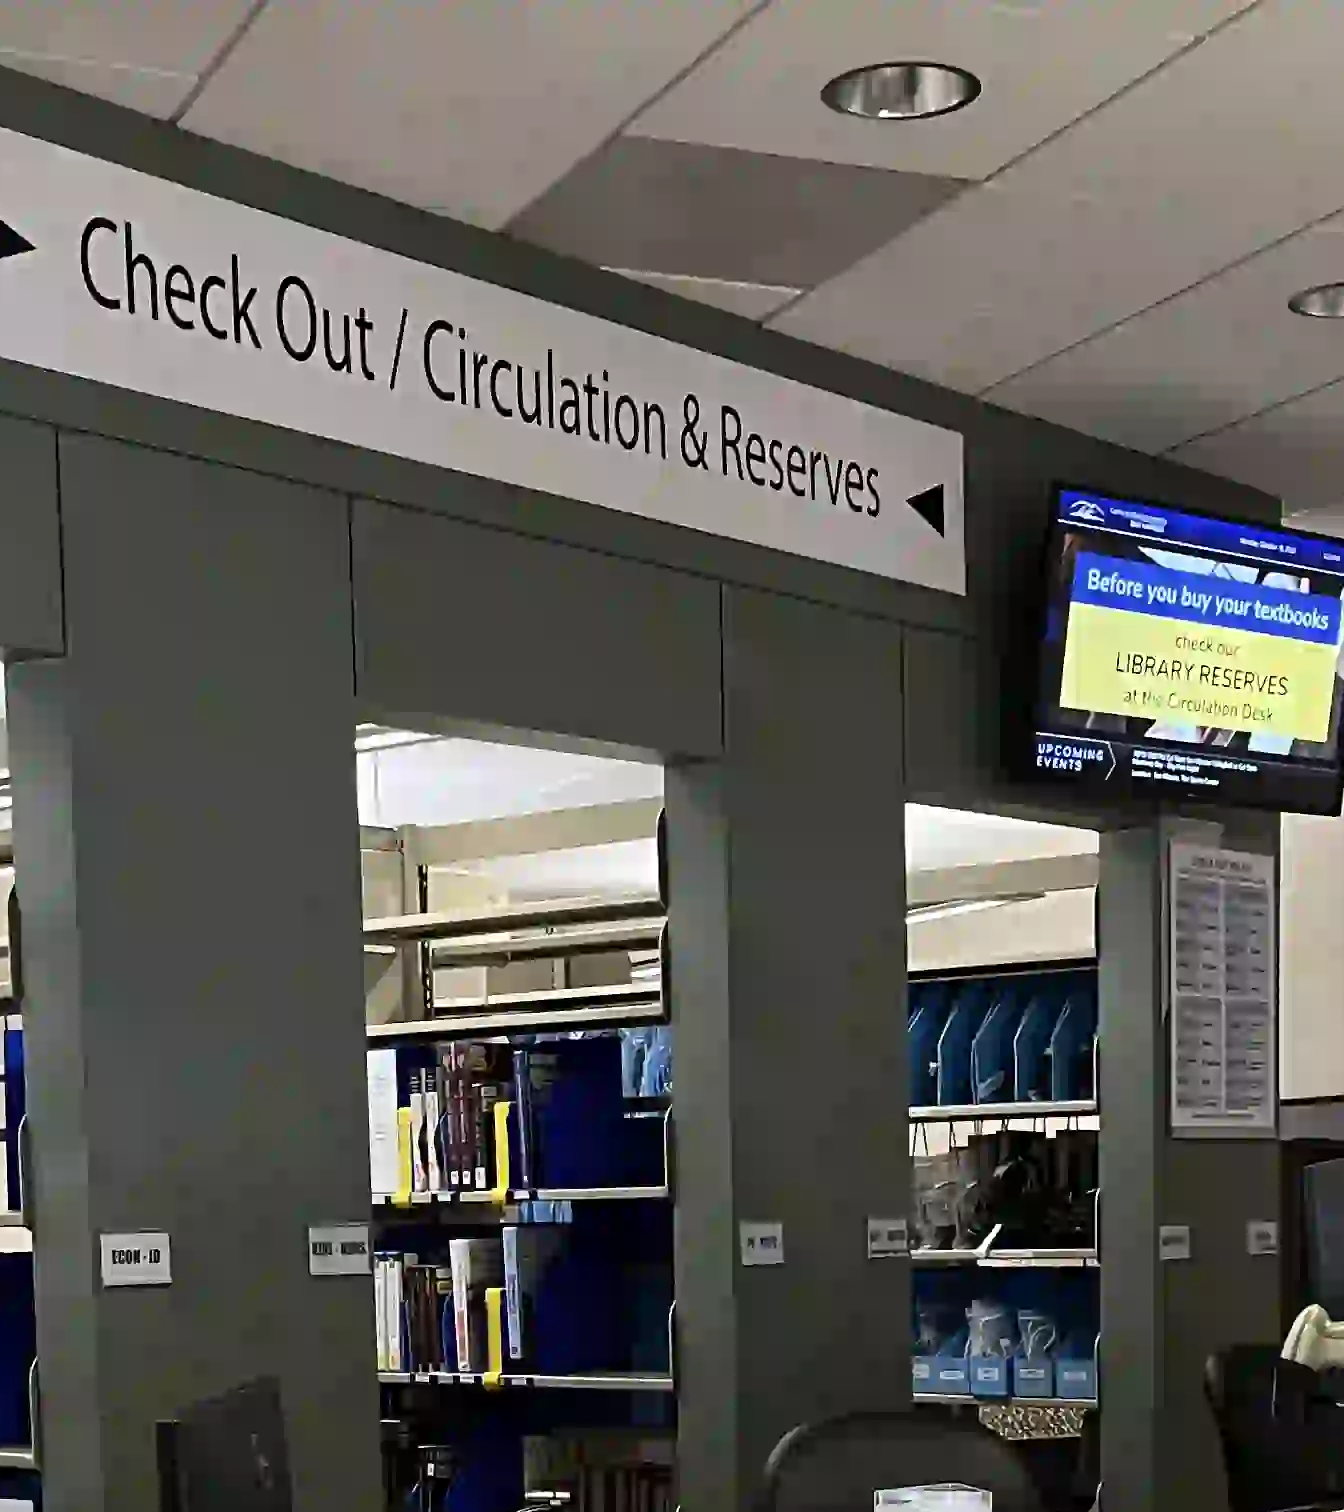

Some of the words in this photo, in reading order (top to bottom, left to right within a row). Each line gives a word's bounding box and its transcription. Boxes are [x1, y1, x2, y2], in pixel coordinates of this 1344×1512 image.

[78, 216, 263, 350] Check
[276, 275, 377, 380] Out
[389, 308, 408, 391] /
[422, 317, 668, 460] Circulation
[679, 393, 712, 469] &
[719, 403, 881, 518] Reserves
[1087, 568, 1144, 599] Before
[1147, 584, 1177, 606] you
[1181, 585, 1209, 616] buy
[1215, 594, 1250, 617] your
[1254, 600, 1329, 632] textbooks
[1175, 633, 1213, 653] check
[1216, 642, 1241, 658] our
[1115, 652, 1196, 683] LIBRARY
[1199, 664, 1290, 697] RESERVES
[1123, 688, 1139, 704] at
[1167, 691, 1239, 718] Circulation
[1242, 702, 1274, 723] Desk
[1036, 755, 1083, 772] EVENTS
[1037, 742, 1105, 762] UPCOMING
[111, 1249, 141, 1265] ECON
